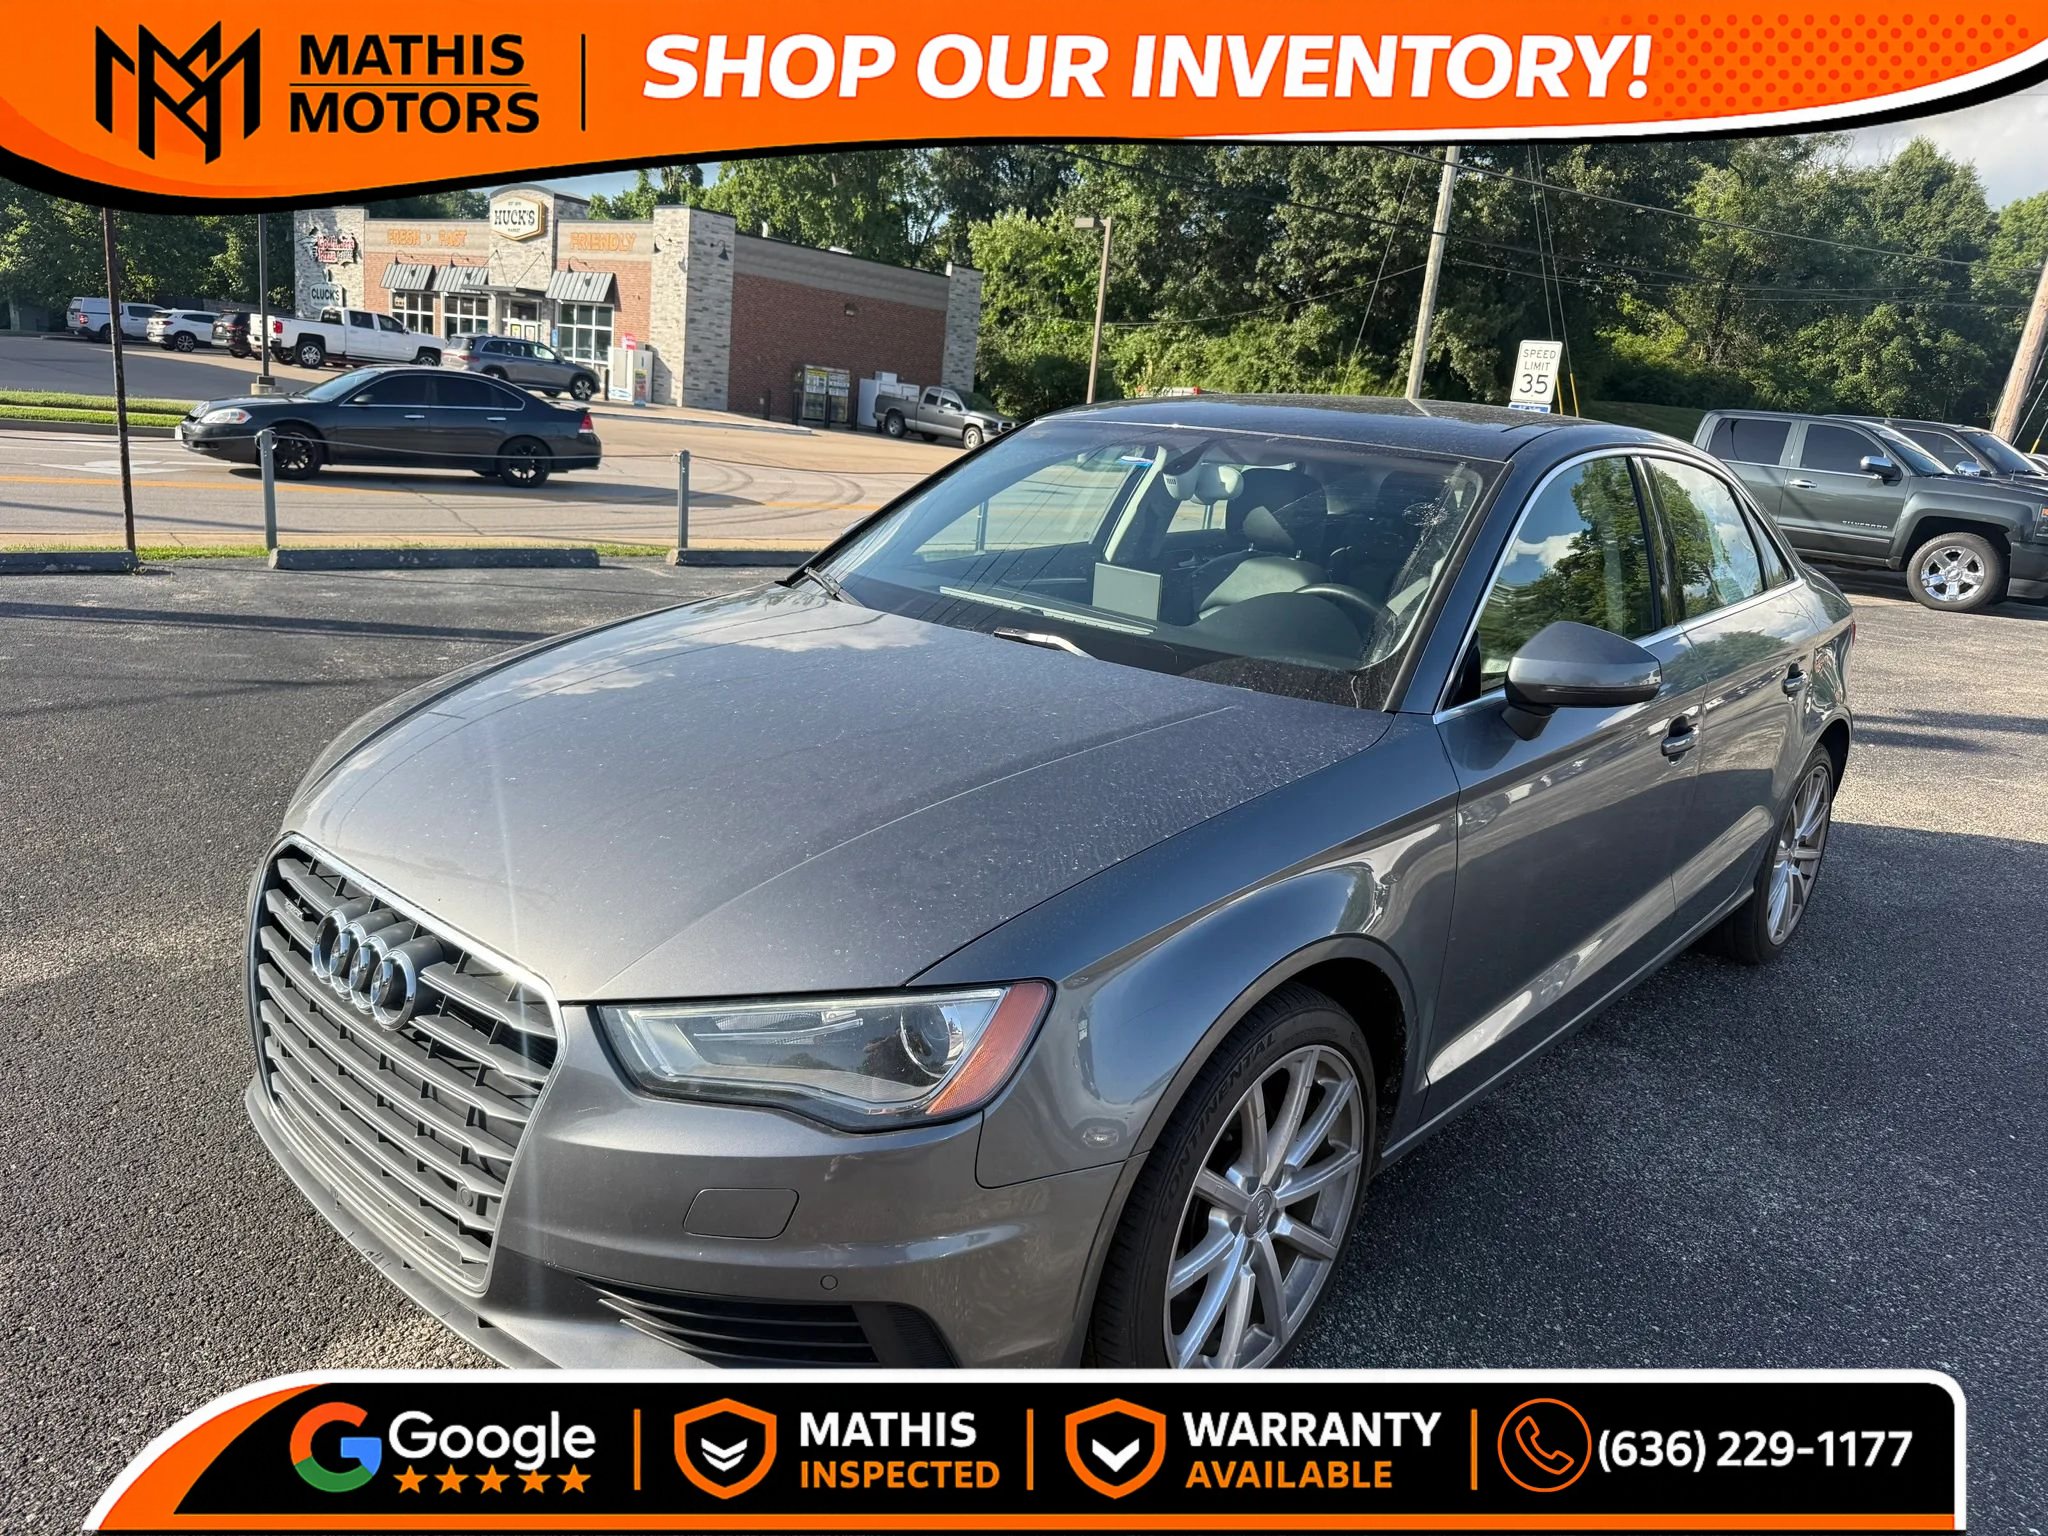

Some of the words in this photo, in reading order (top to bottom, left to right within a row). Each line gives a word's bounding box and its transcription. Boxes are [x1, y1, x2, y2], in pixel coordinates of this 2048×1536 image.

[494, 209, 535, 225] HUCK'S
[387, 229, 420, 246] FRESH
[439, 230, 467, 247] FAST
[570, 232, 637, 251] FRIENDLY
[1522, 348, 1557, 359] SPEED
[1524, 361, 1551, 371] LIMIT
[1519, 373, 1549, 394] 35
